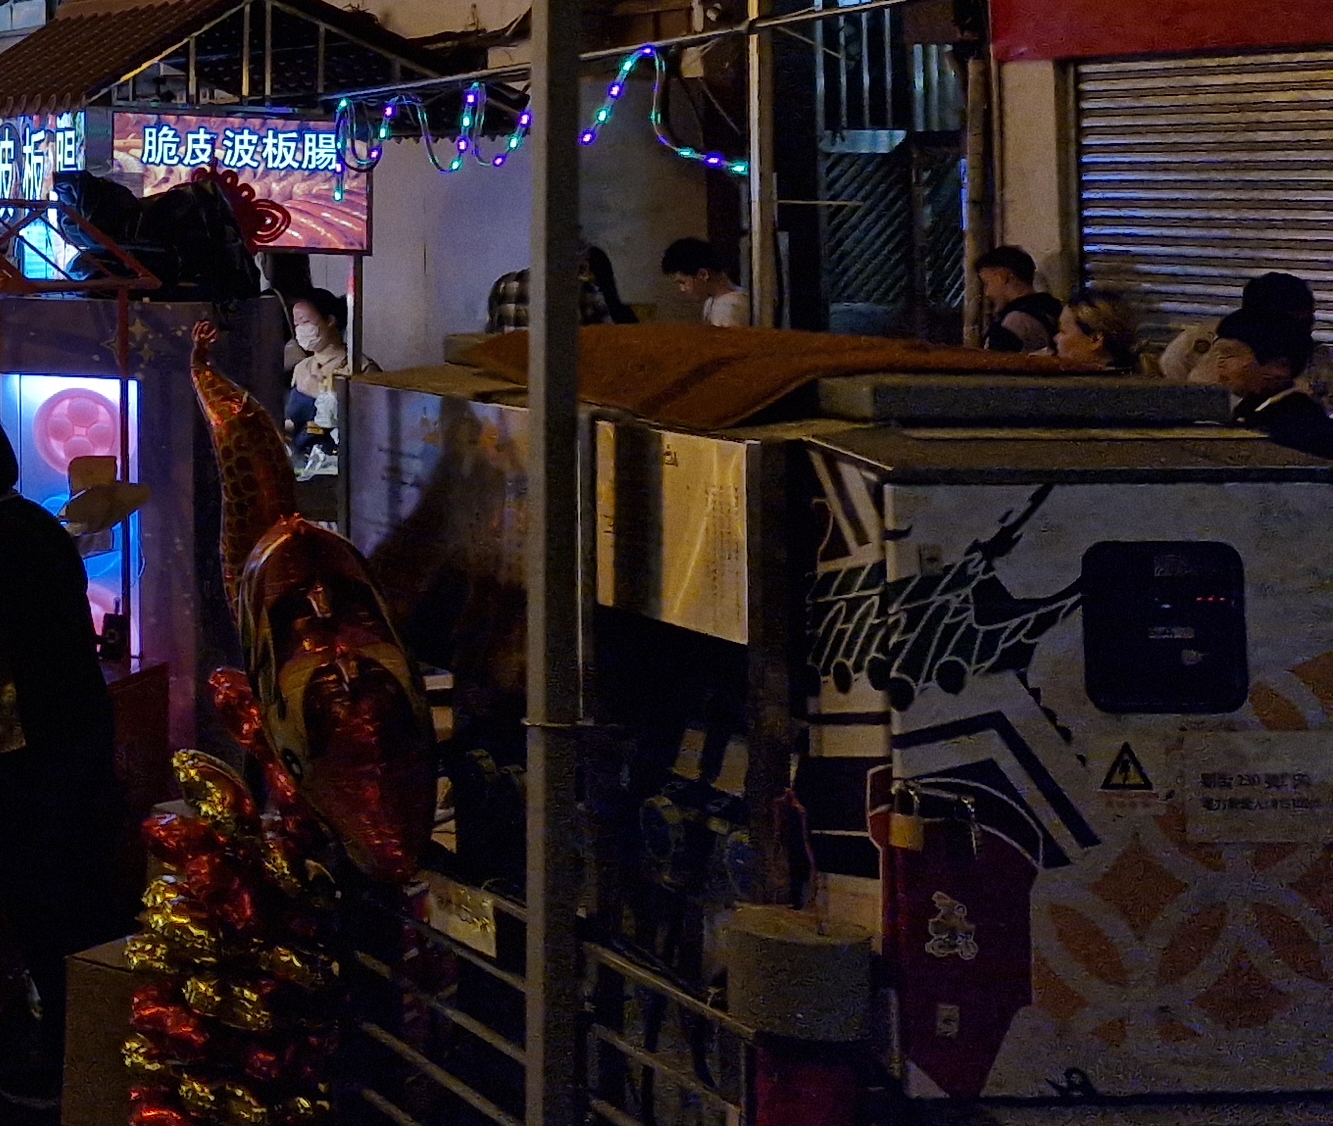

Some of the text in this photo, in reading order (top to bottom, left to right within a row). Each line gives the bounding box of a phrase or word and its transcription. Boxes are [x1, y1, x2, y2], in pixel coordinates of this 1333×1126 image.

[142, 127, 336, 170] 脆皮波板腸
